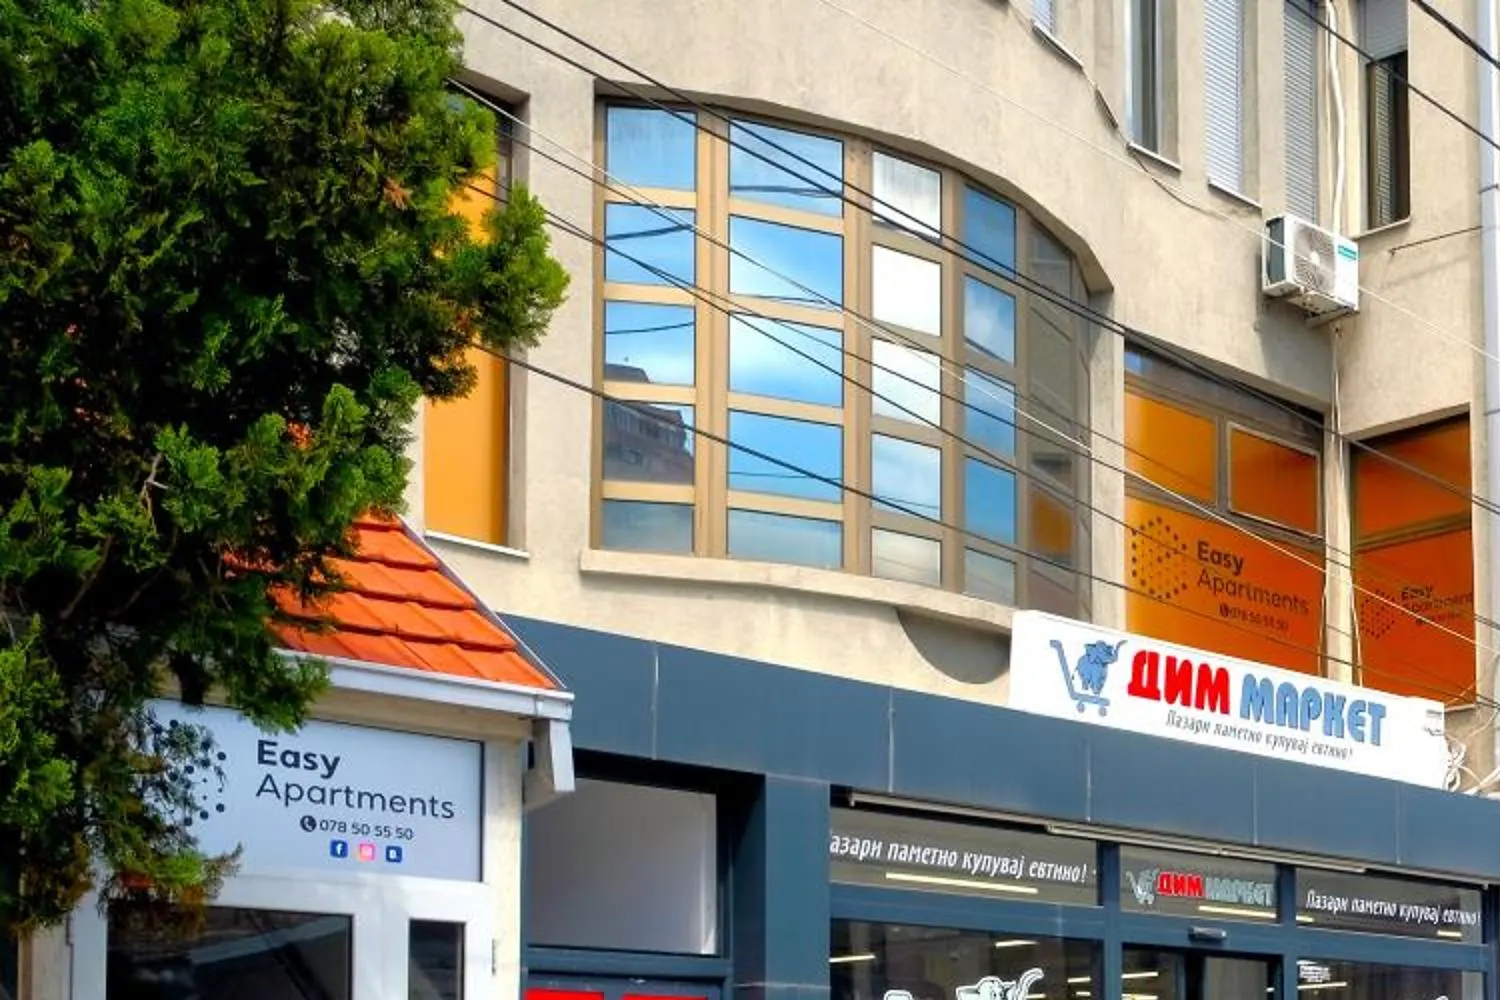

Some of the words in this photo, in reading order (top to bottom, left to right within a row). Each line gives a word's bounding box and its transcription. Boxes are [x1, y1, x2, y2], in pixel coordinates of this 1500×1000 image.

[1196, 540, 1244, 575] Easy
[1196, 568, 1309, 615] Apartments
[1127, 649, 1231, 715] ДИМ
[1239, 673, 1387, 746] МАРКЕТ
[1165, 709, 1211, 735] Пазари
[1213, 722, 1263, 745] паметно
[257, 739, 341, 779] Easy
[255, 773, 455, 819] Apartments
[319, 819, 347, 833] 078
[351, 823, 371, 837] 50
[375, 825, 392, 839] 55
[395, 828, 414, 841] 50
[829, 830, 883, 860] азари
[887, 841, 958, 868] паметно
[961, 850, 1025, 881] купувај
[1028, 860, 1089, 884] евтино!
[1155, 870, 1206, 897] ДИМ
[1305, 889, 1349, 915] Пазари
[1351, 897, 1397, 917] паметно
[1399, 903, 1441, 925] купувај
